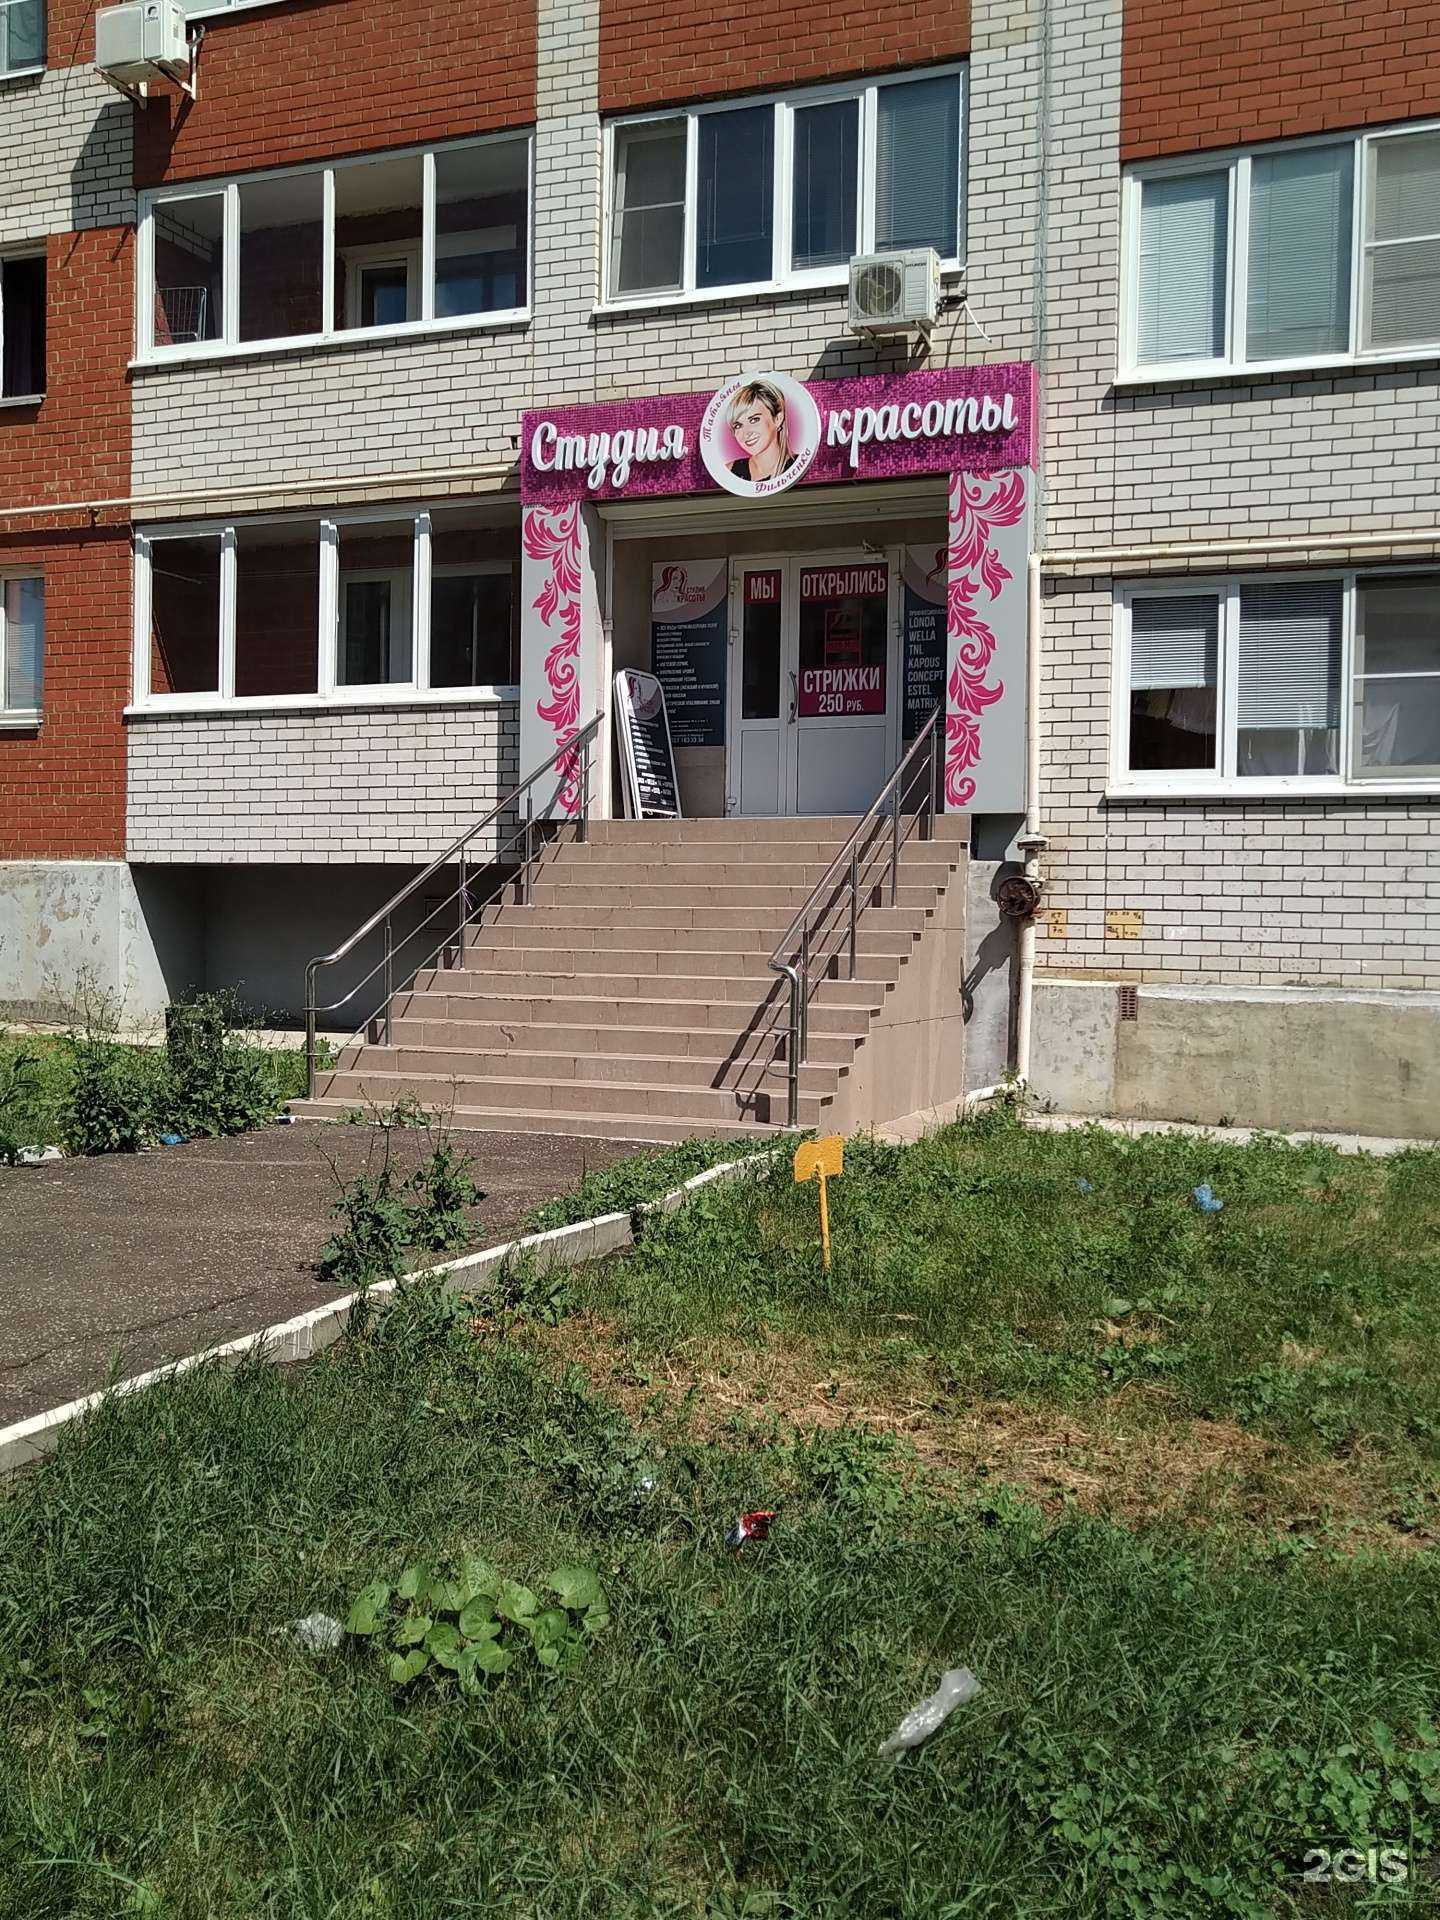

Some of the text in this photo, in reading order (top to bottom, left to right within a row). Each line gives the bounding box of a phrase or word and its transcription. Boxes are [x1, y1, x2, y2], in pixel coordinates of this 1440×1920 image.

[531, 393, 1019, 491] Студия красоты
[754, 448, 811, 494] Фильченко
[750, 569, 886, 600] МЫ ОТКРЫЛИСЬ
[909, 616, 936, 629] LONDA
[909, 630, 936, 642] WELLA
[909, 644, 924, 655] TNL
[908, 657, 940, 669] KAPOUS
[803, 666, 880, 693] СТРИЖКИ
[908, 669, 944, 682] CONCEPT
[908, 684, 932, 696] ESTEL
[818, 693, 865, 713] 250 РУБ.
